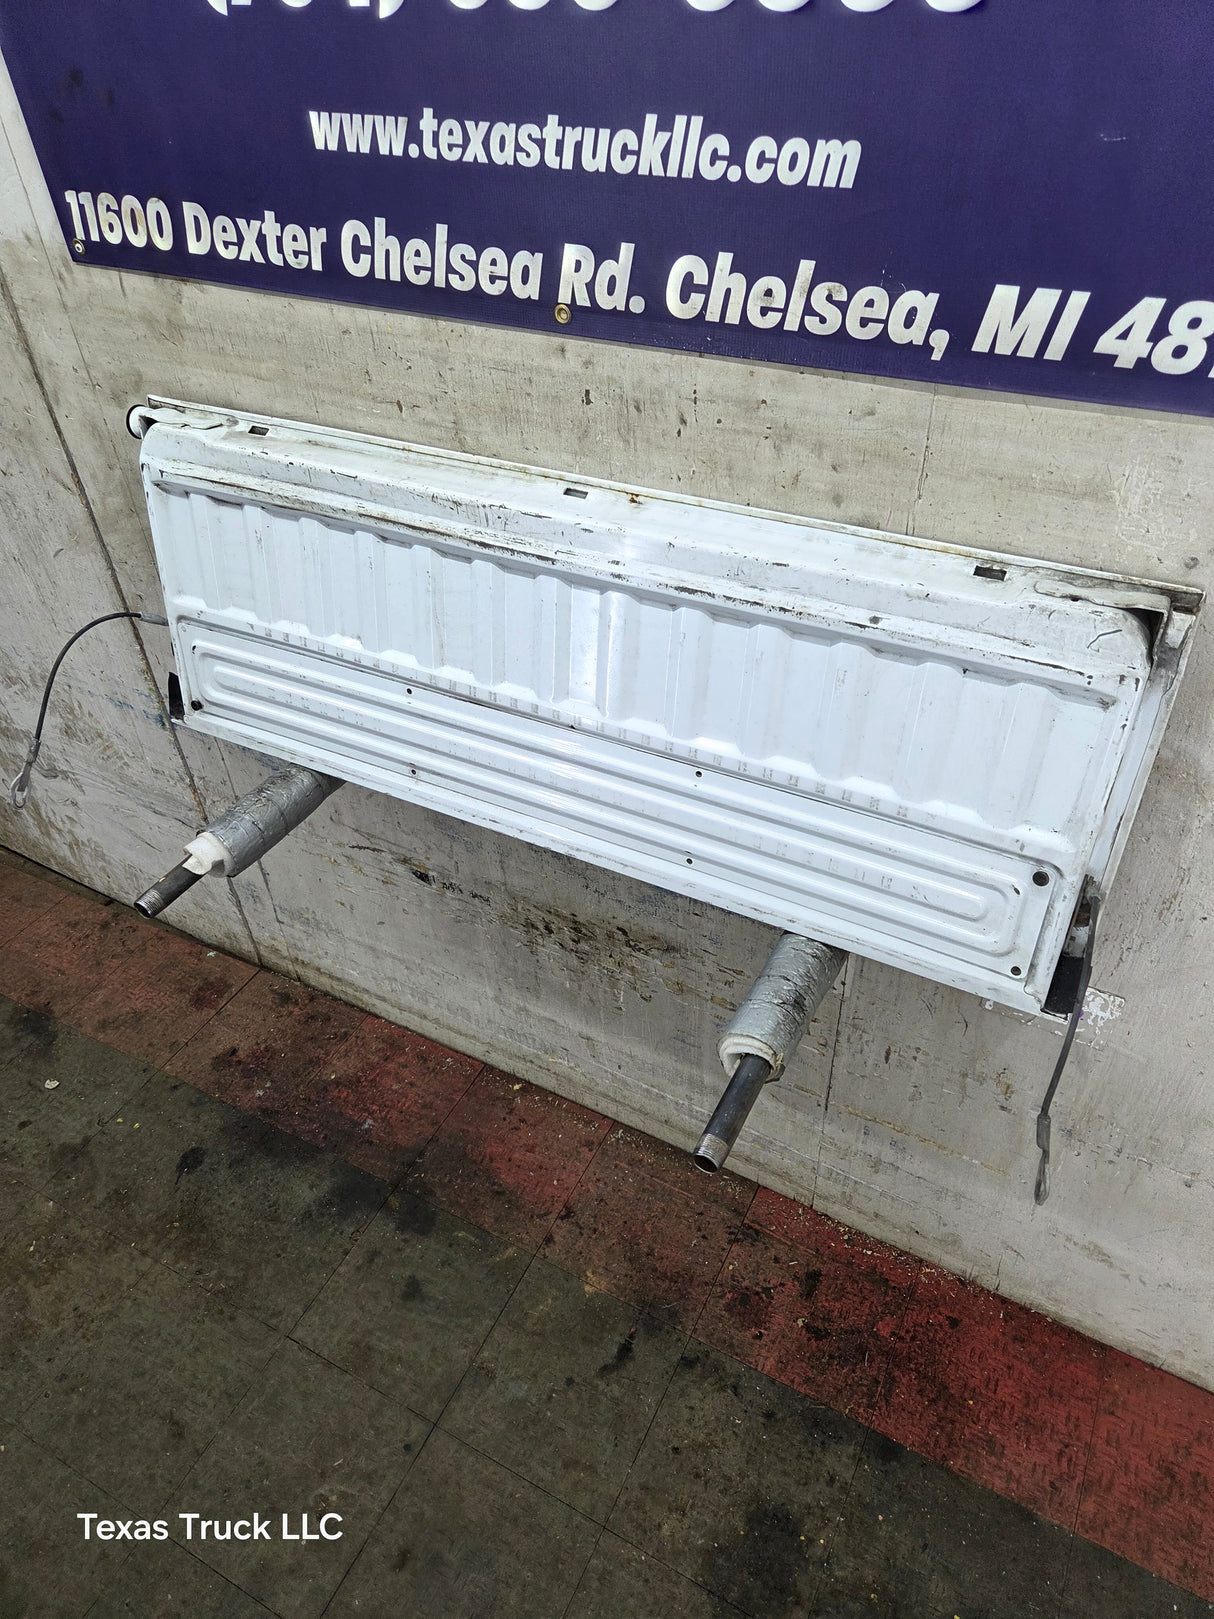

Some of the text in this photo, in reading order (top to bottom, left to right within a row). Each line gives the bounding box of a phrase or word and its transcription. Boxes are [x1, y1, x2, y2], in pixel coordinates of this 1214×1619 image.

[309, 108, 862, 189] www.texastruckllc.com
[64, 189, 1214, 379] 11600 Dexter Chelsea Rd. Chelsea, MI 48
